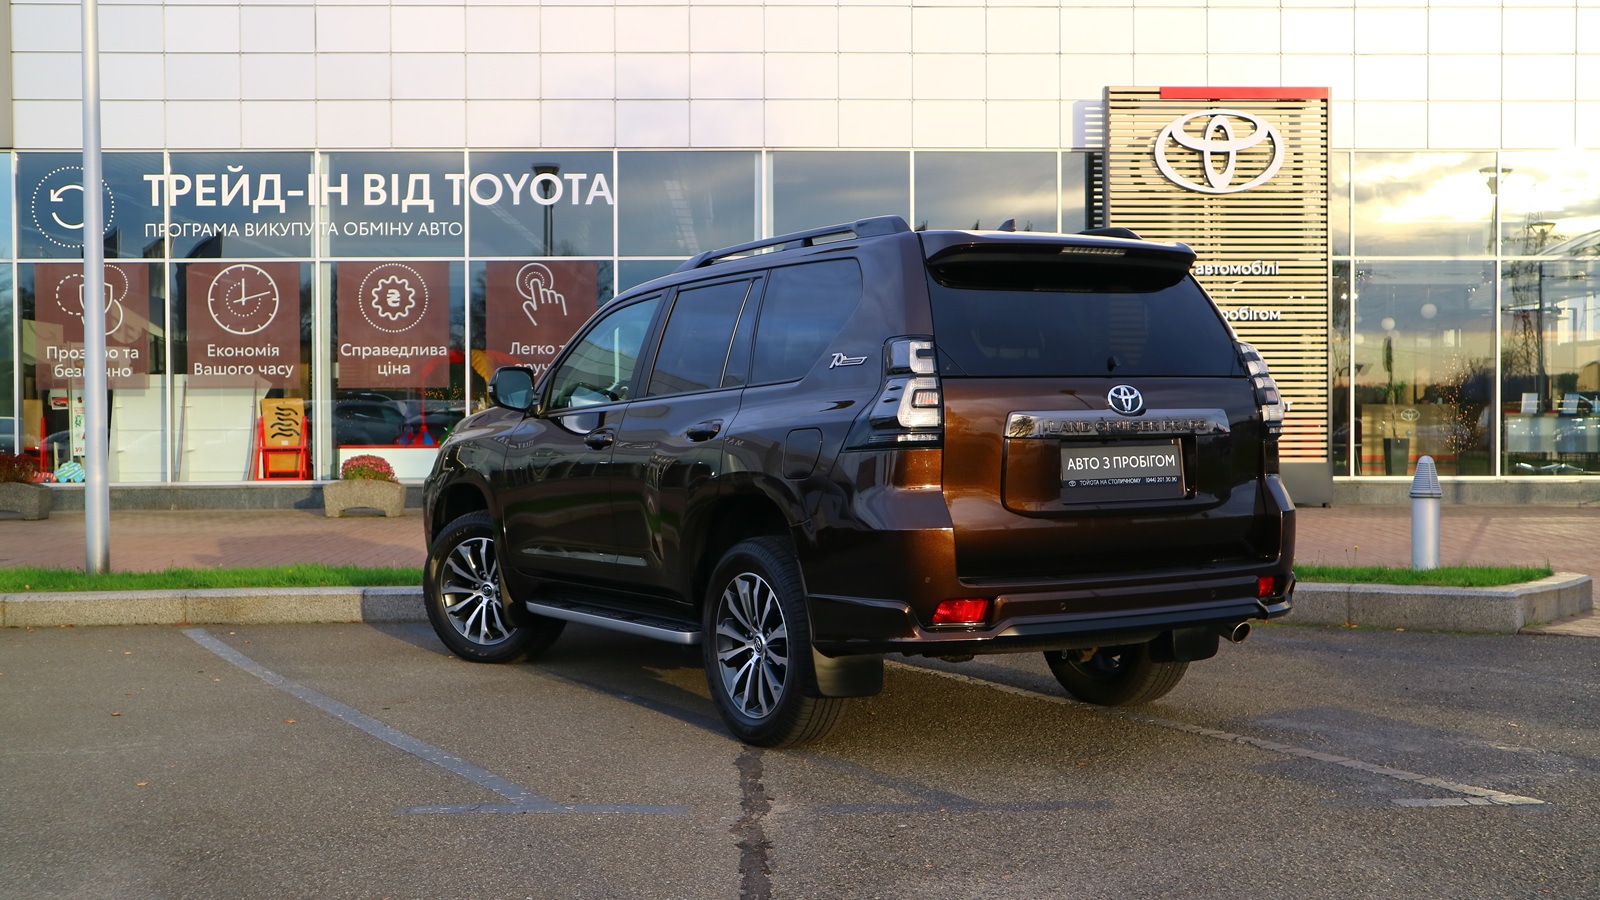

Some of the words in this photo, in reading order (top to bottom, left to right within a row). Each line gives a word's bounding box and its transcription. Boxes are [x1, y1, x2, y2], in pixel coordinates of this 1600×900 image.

[143, 165, 348, 214] ТРЕЙД-ІН
[363, 173, 435, 213] ВІД
[444, 173, 614, 206] TOYOTA
[145, 222, 240, 237] ПРОГРАМА
[245, 222, 314, 237] ВИКУПУ
[319, 222, 339, 236] ТА
[343, 222, 414, 236] ОБМІНУ
[418, 222, 463, 236] АВТО
[1195, 260, 1280, 275] автомобілі
[1221, 306, 1281, 321] робігом
[46, 346, 119, 362] Прозо
[122, 348, 139, 359] та
[207, 344, 280, 357] Економія
[340, 343, 447, 359] Справедлива
[509, 342, 555, 355] Легко
[194, 363, 254, 376] Вашого
[258, 365, 294, 378] часу
[377, 362, 411, 375] ціна
[1048, 420, 1091, 433] LAND
[1095, 419, 1159, 432] CRUISER
[1162, 418, 1207, 431] PRADO
[1067, 457, 1100, 470] АВТО
[1113, 454, 1176, 468] ПРОБІГОМ
